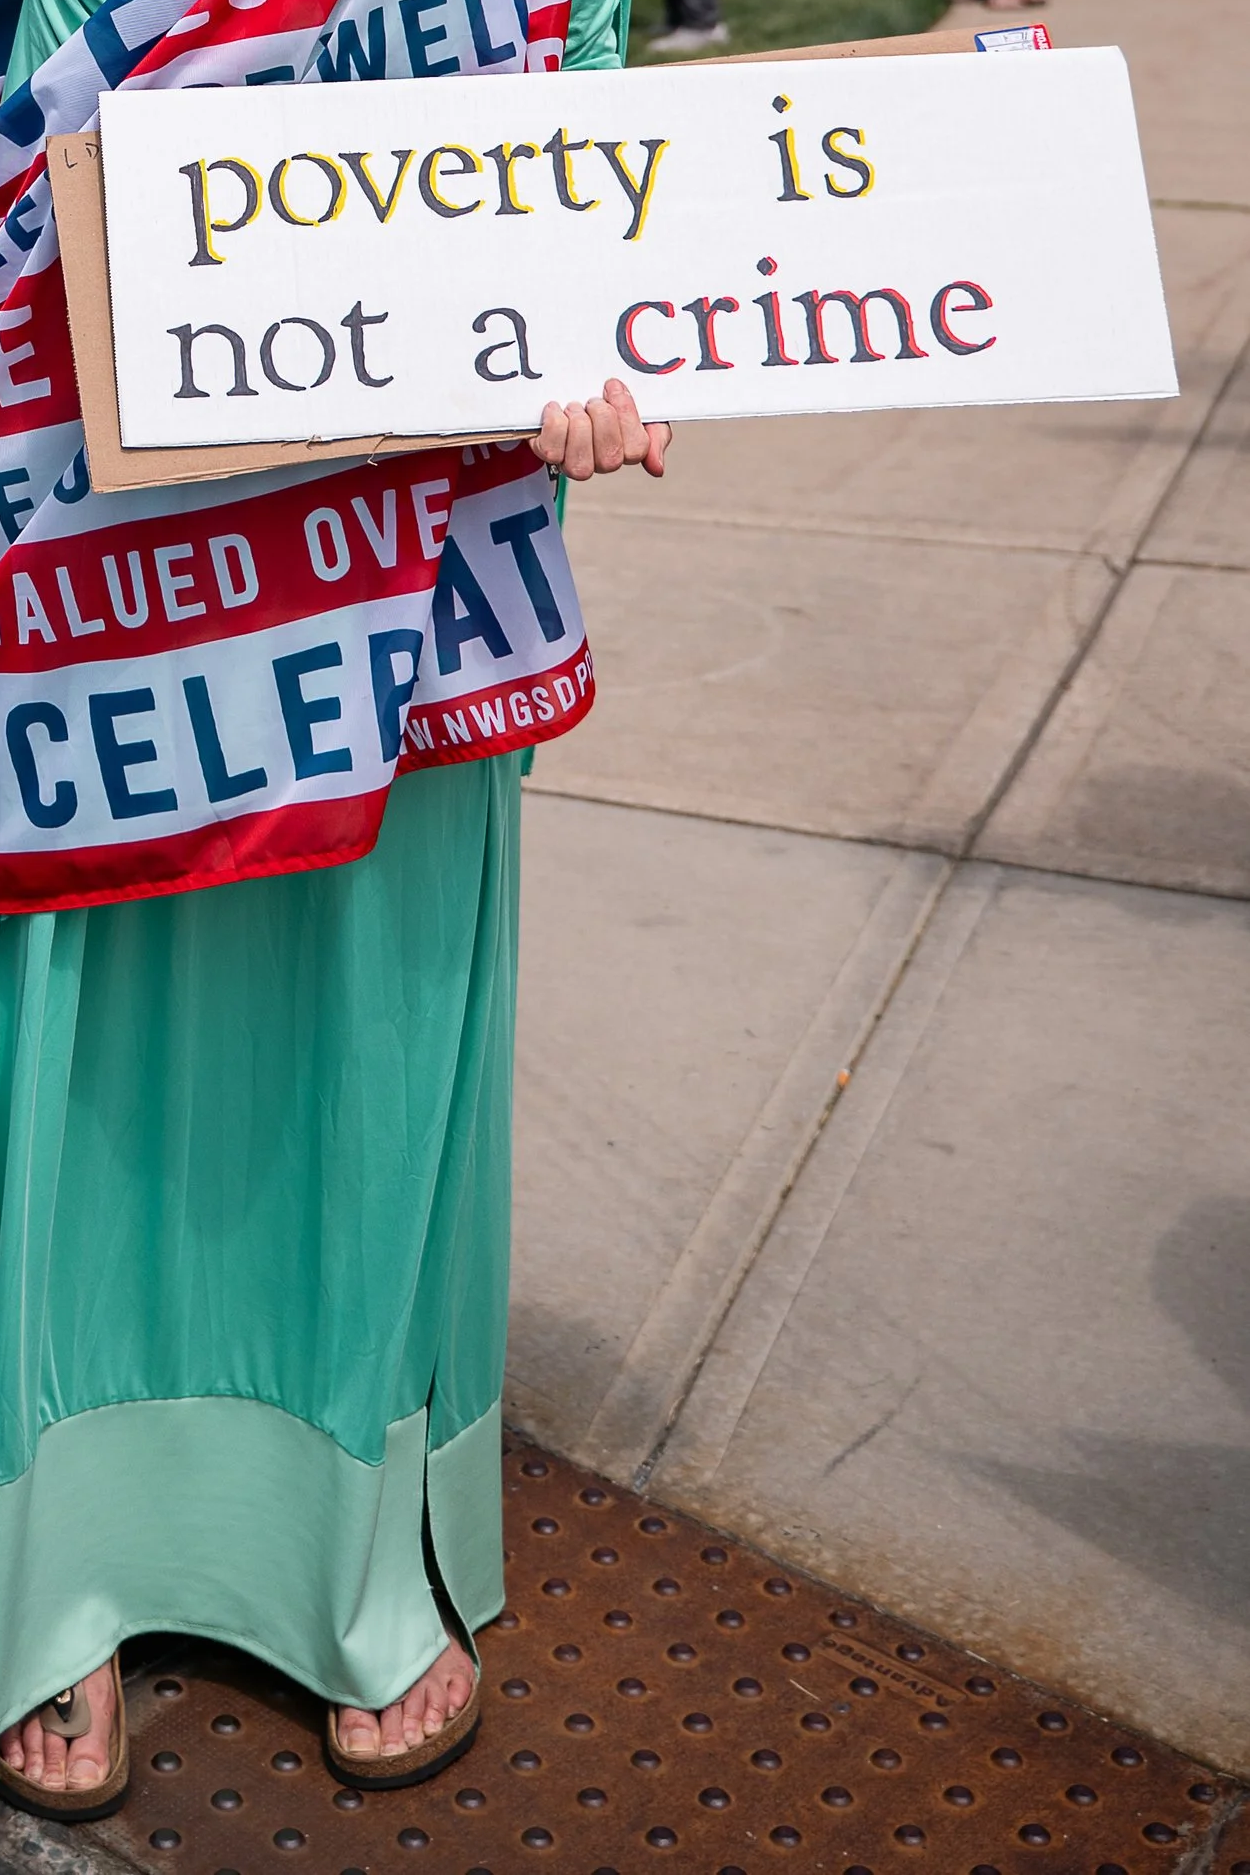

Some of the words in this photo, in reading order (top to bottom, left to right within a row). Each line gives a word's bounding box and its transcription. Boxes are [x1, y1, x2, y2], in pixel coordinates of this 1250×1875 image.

[179, 128, 670, 266] poverty
[769, 95, 874, 201] is
[167, 301, 393, 398] not
[472, 308, 542, 381] a
[616, 256, 997, 375] crime
